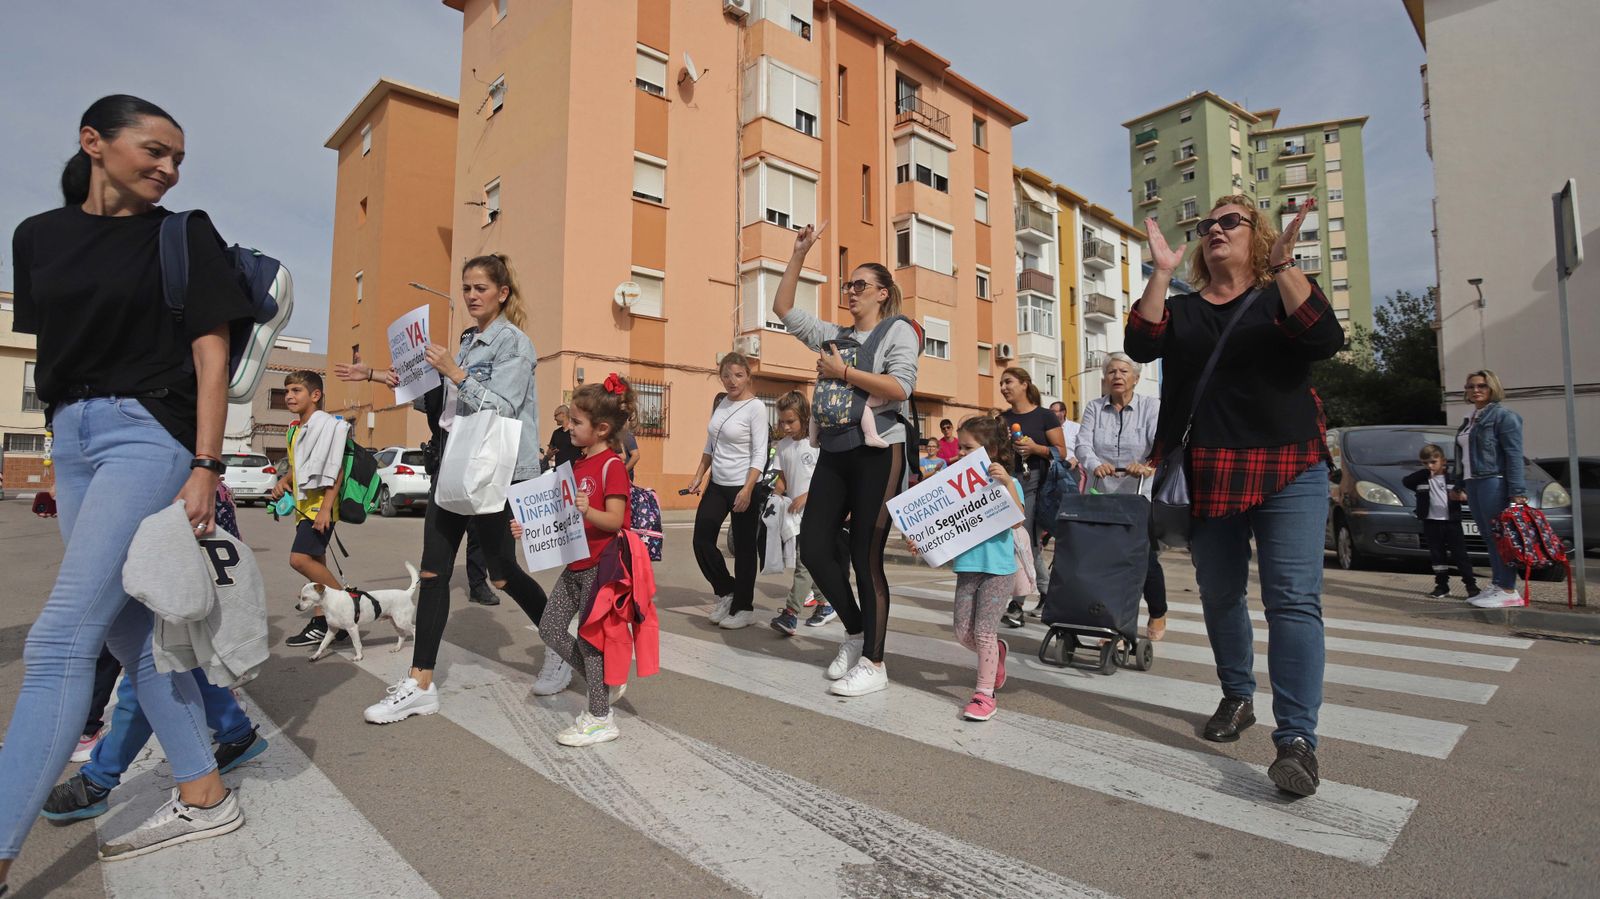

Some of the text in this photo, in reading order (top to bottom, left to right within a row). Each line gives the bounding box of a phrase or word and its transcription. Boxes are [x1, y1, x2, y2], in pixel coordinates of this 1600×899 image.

[406, 318, 428, 349] YA!
[523, 487, 561, 506] COMEDO
[526, 499, 564, 521] INFANT
[903, 486, 945, 515] COMEDOR
[906, 495, 955, 527] INFANTIL
[909, 530, 925, 543] Por
[925, 525, 936, 537] la
[935, 493, 989, 530] Seguridad
[989, 488, 1003, 502] de
[525, 528, 541, 540] Por
[542, 523, 552, 536] la
[529, 536, 567, 554] nuestros
[917, 513, 984, 554] nuestros hij@s
[199, 540, 240, 586] P
